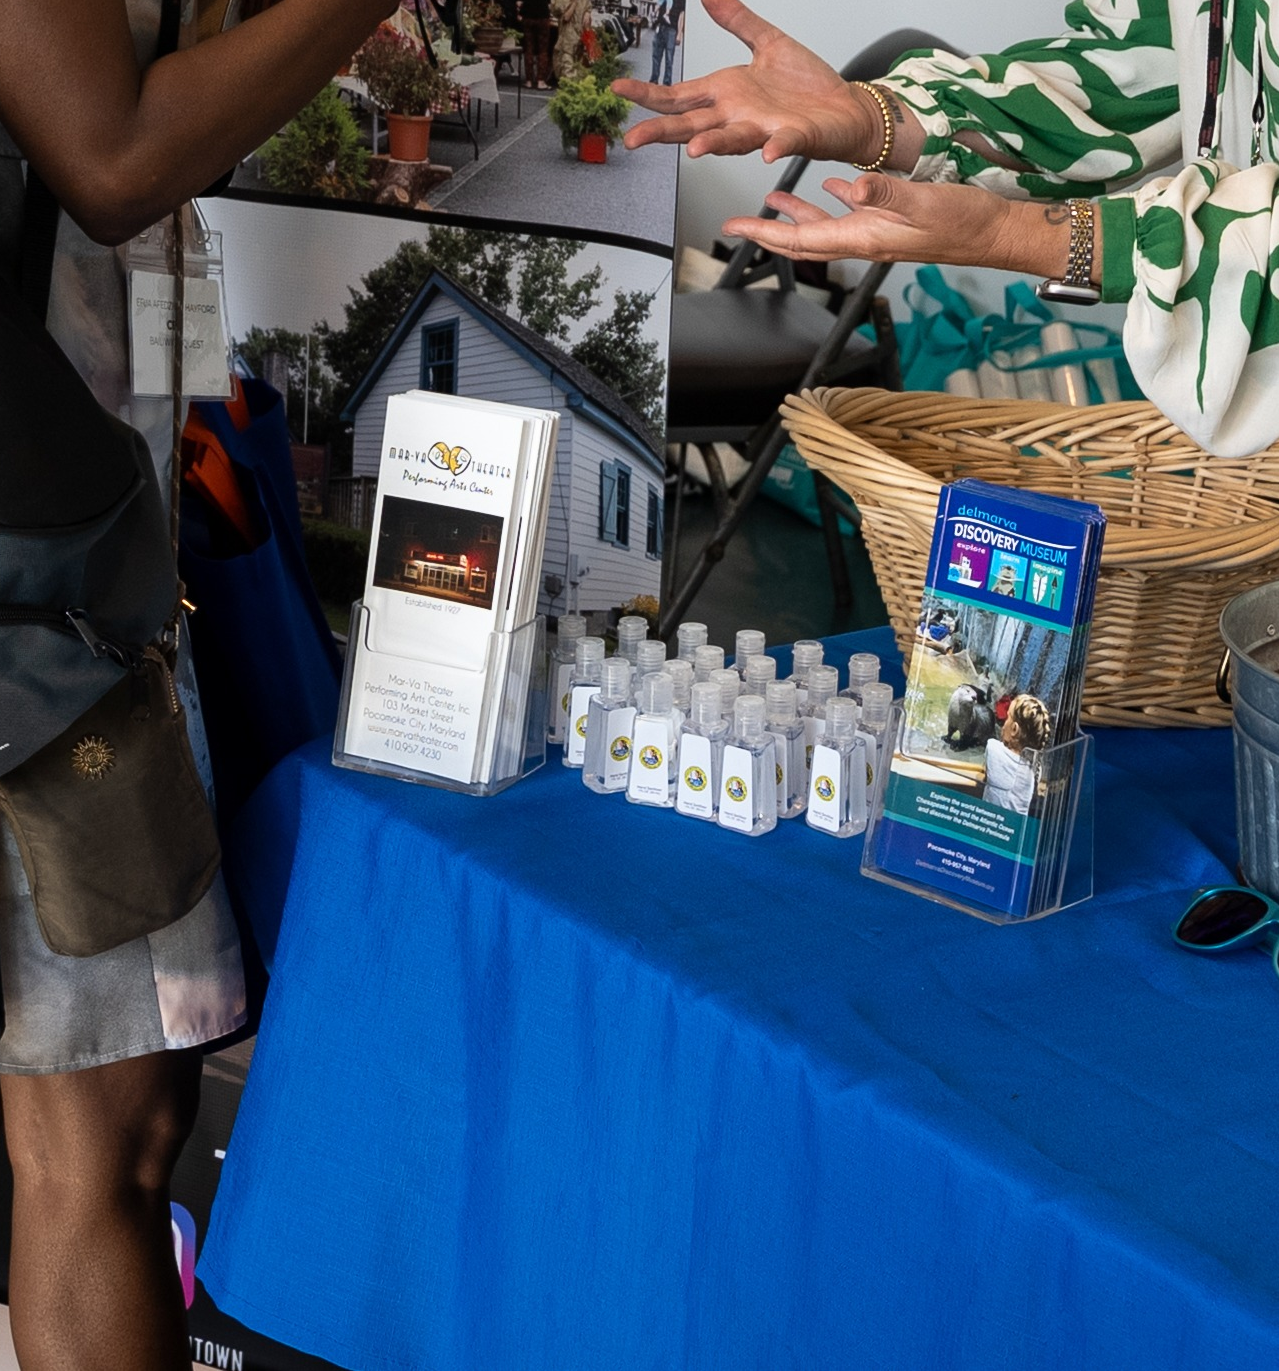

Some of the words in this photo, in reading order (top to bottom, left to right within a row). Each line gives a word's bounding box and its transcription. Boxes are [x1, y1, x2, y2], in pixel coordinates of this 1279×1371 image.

[471, 460, 511, 478] THEATER
[402, 469, 448, 491] Performing
[449, 478, 467, 491] Arts
[469, 482, 494, 496] Center
[957, 504, 1018, 532] delmarva
[953, 522, 1020, 552] DISCOVERY
[1019, 540, 1068, 566] MUSEUM
[956, 542, 986, 555] explore
[999, 552, 1021, 564] learn
[1032, 561, 1063, 577] imagine
[404, 596, 442, 612] Established
[445, 605, 461, 615] 1927
[364, 681, 408, 701] Performing
[410, 692, 426, 704] Arts
[388, 673, 421, 690] Mar-Va
[423, 681, 454, 697] Theater
[382, 698, 398, 711] 103
[400, 702, 429, 718] Market
[430, 709, 454, 724] Street
[363, 707, 407, 726] Pocomoke
[408, 717, 427, 732] City,
[428, 722, 466, 741] Maryland
[929, 791, 951, 804] Explore
[927, 842, 956, 857] Pocomoke
[967, 855, 991, 870] Maryland
[188, 1334, 243, 1371] TOWN
